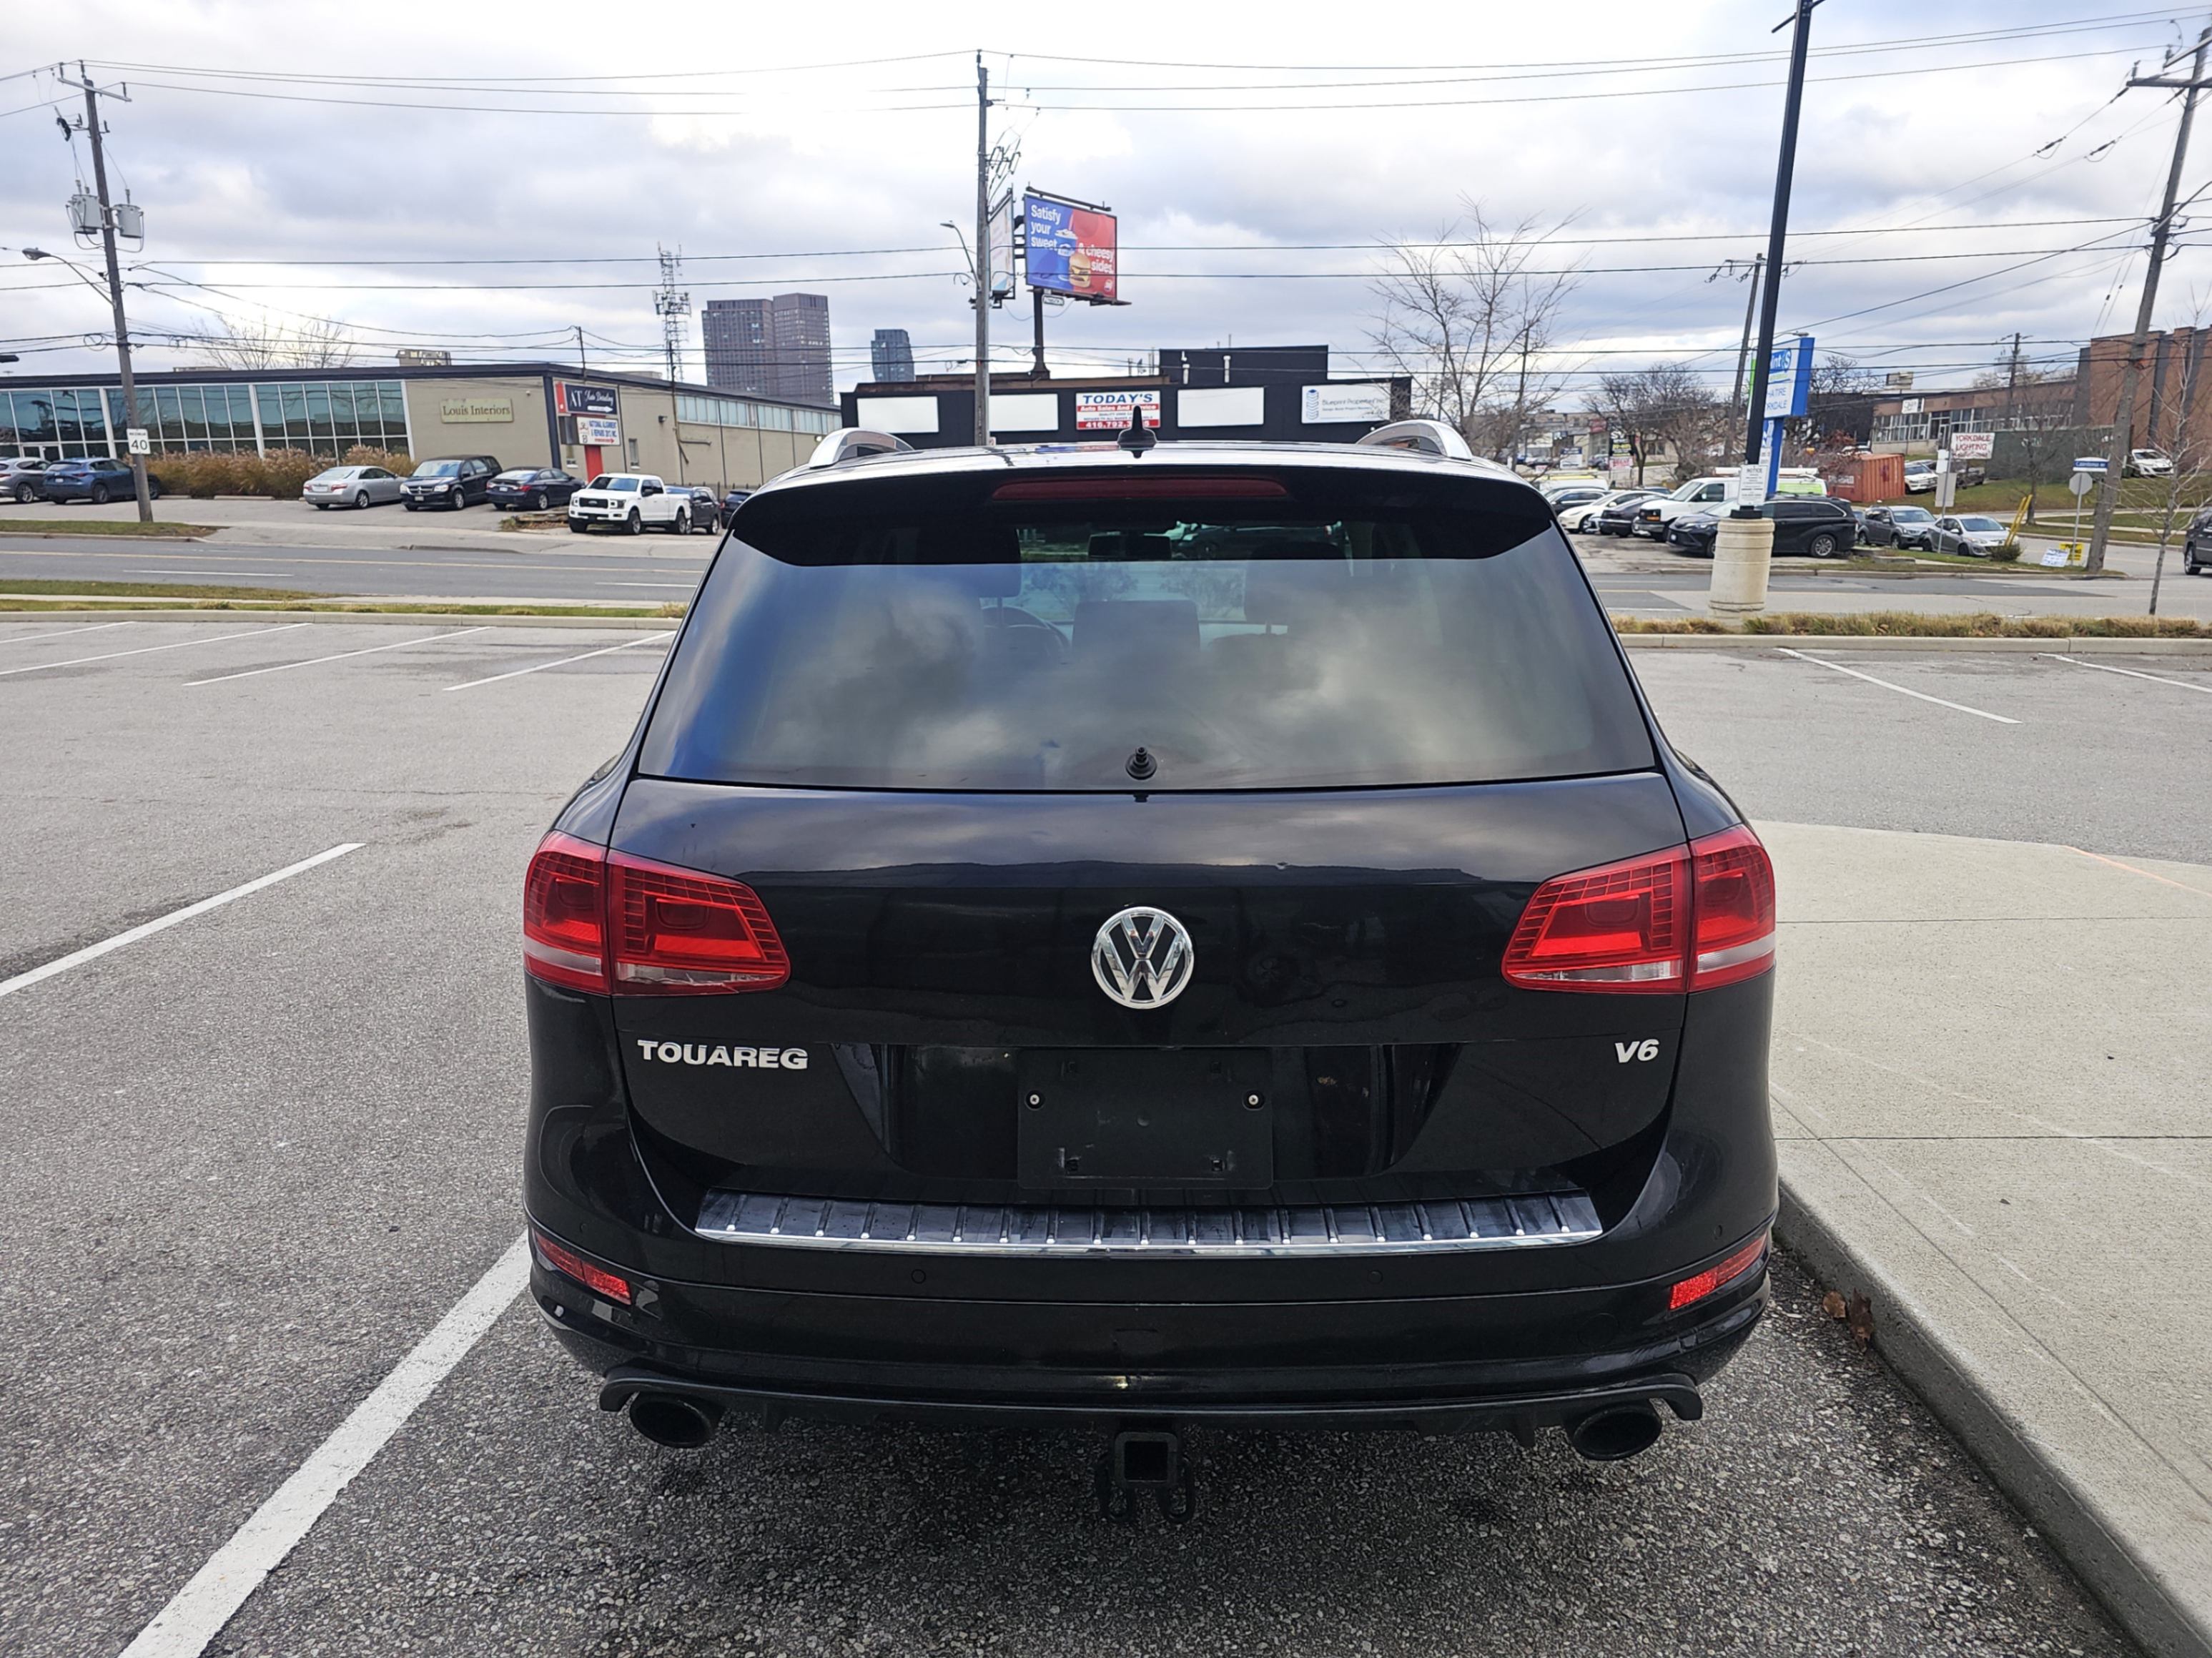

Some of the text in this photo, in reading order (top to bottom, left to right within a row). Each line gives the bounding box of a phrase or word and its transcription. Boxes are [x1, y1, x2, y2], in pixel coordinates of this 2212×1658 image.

[1031, 204, 1061, 224] Satisfy
[1031, 221, 1051, 235] your
[1031, 237, 1057, 252] sweet
[1078, 242, 1114, 262] & cheesy
[570, 390, 583, 407] AT
[1082, 393, 1152, 404] TODAY'S
[443, 405, 510, 415] Louis Interiors
[131, 439, 148, 450] 40
[637, 1039, 809, 1070] TOUAREG
[1614, 1038, 1660, 1064] V6
